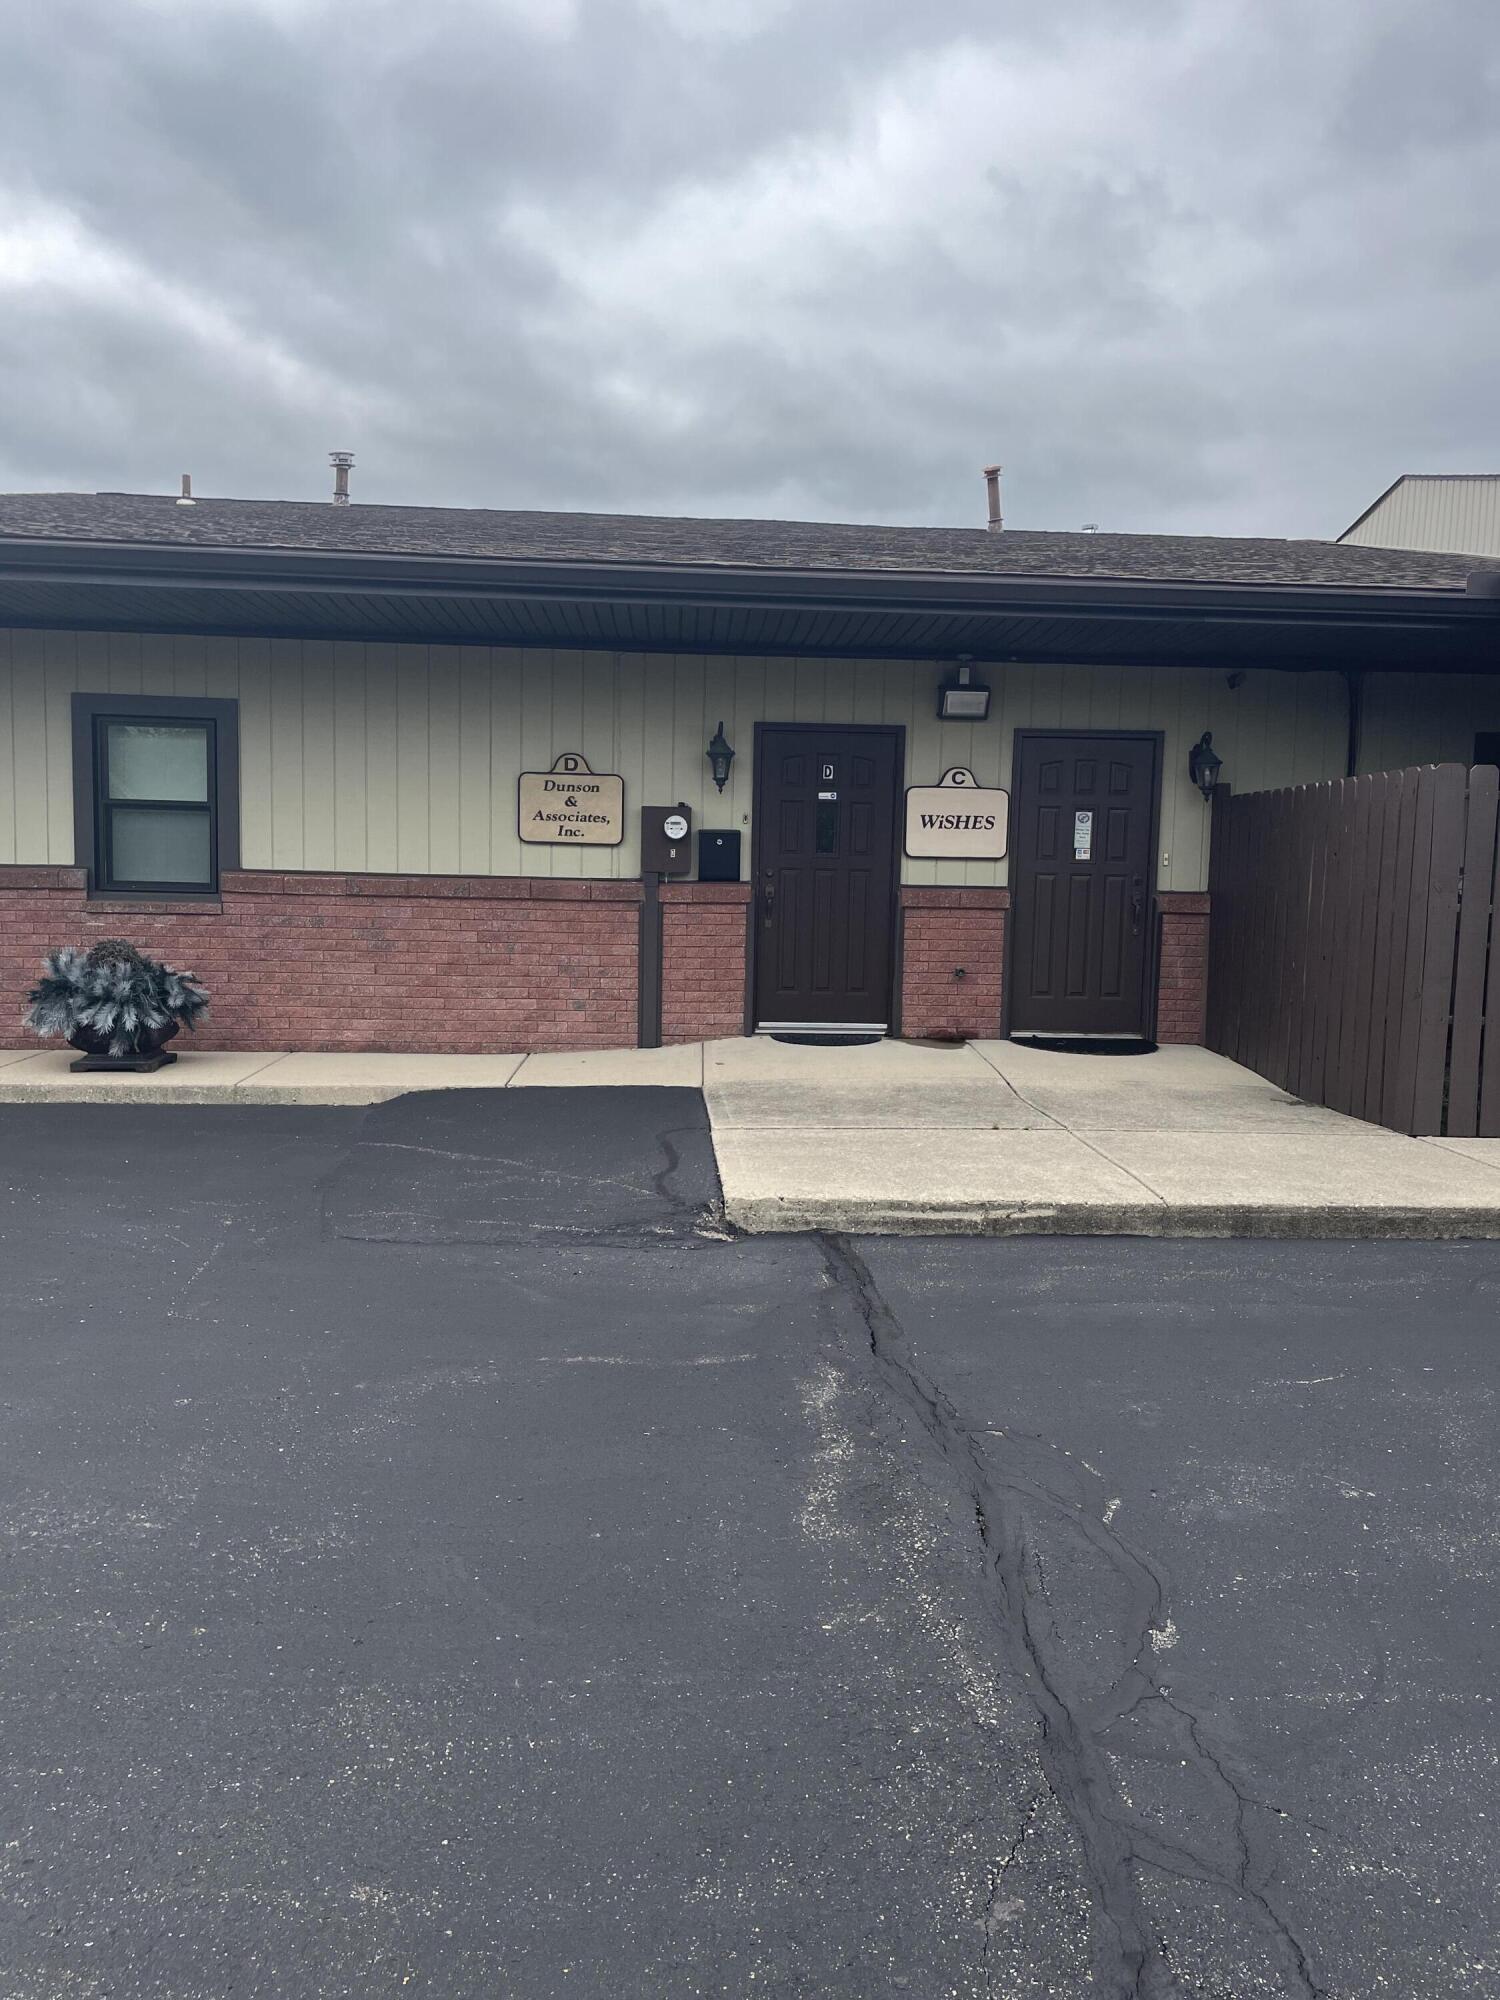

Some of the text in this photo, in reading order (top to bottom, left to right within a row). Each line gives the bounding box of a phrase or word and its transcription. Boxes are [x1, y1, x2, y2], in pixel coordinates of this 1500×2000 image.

[563, 757, 579, 771] D
[824, 765, 833, 778] D
[951, 771, 966, 785] C
[543, 779, 600, 793] Dunson
[564, 795, 578, 807] &
[532, 809, 611, 825] Associates,
[920, 814, 996, 830] WiSHES
[557, 825, 585, 837] Inc.
